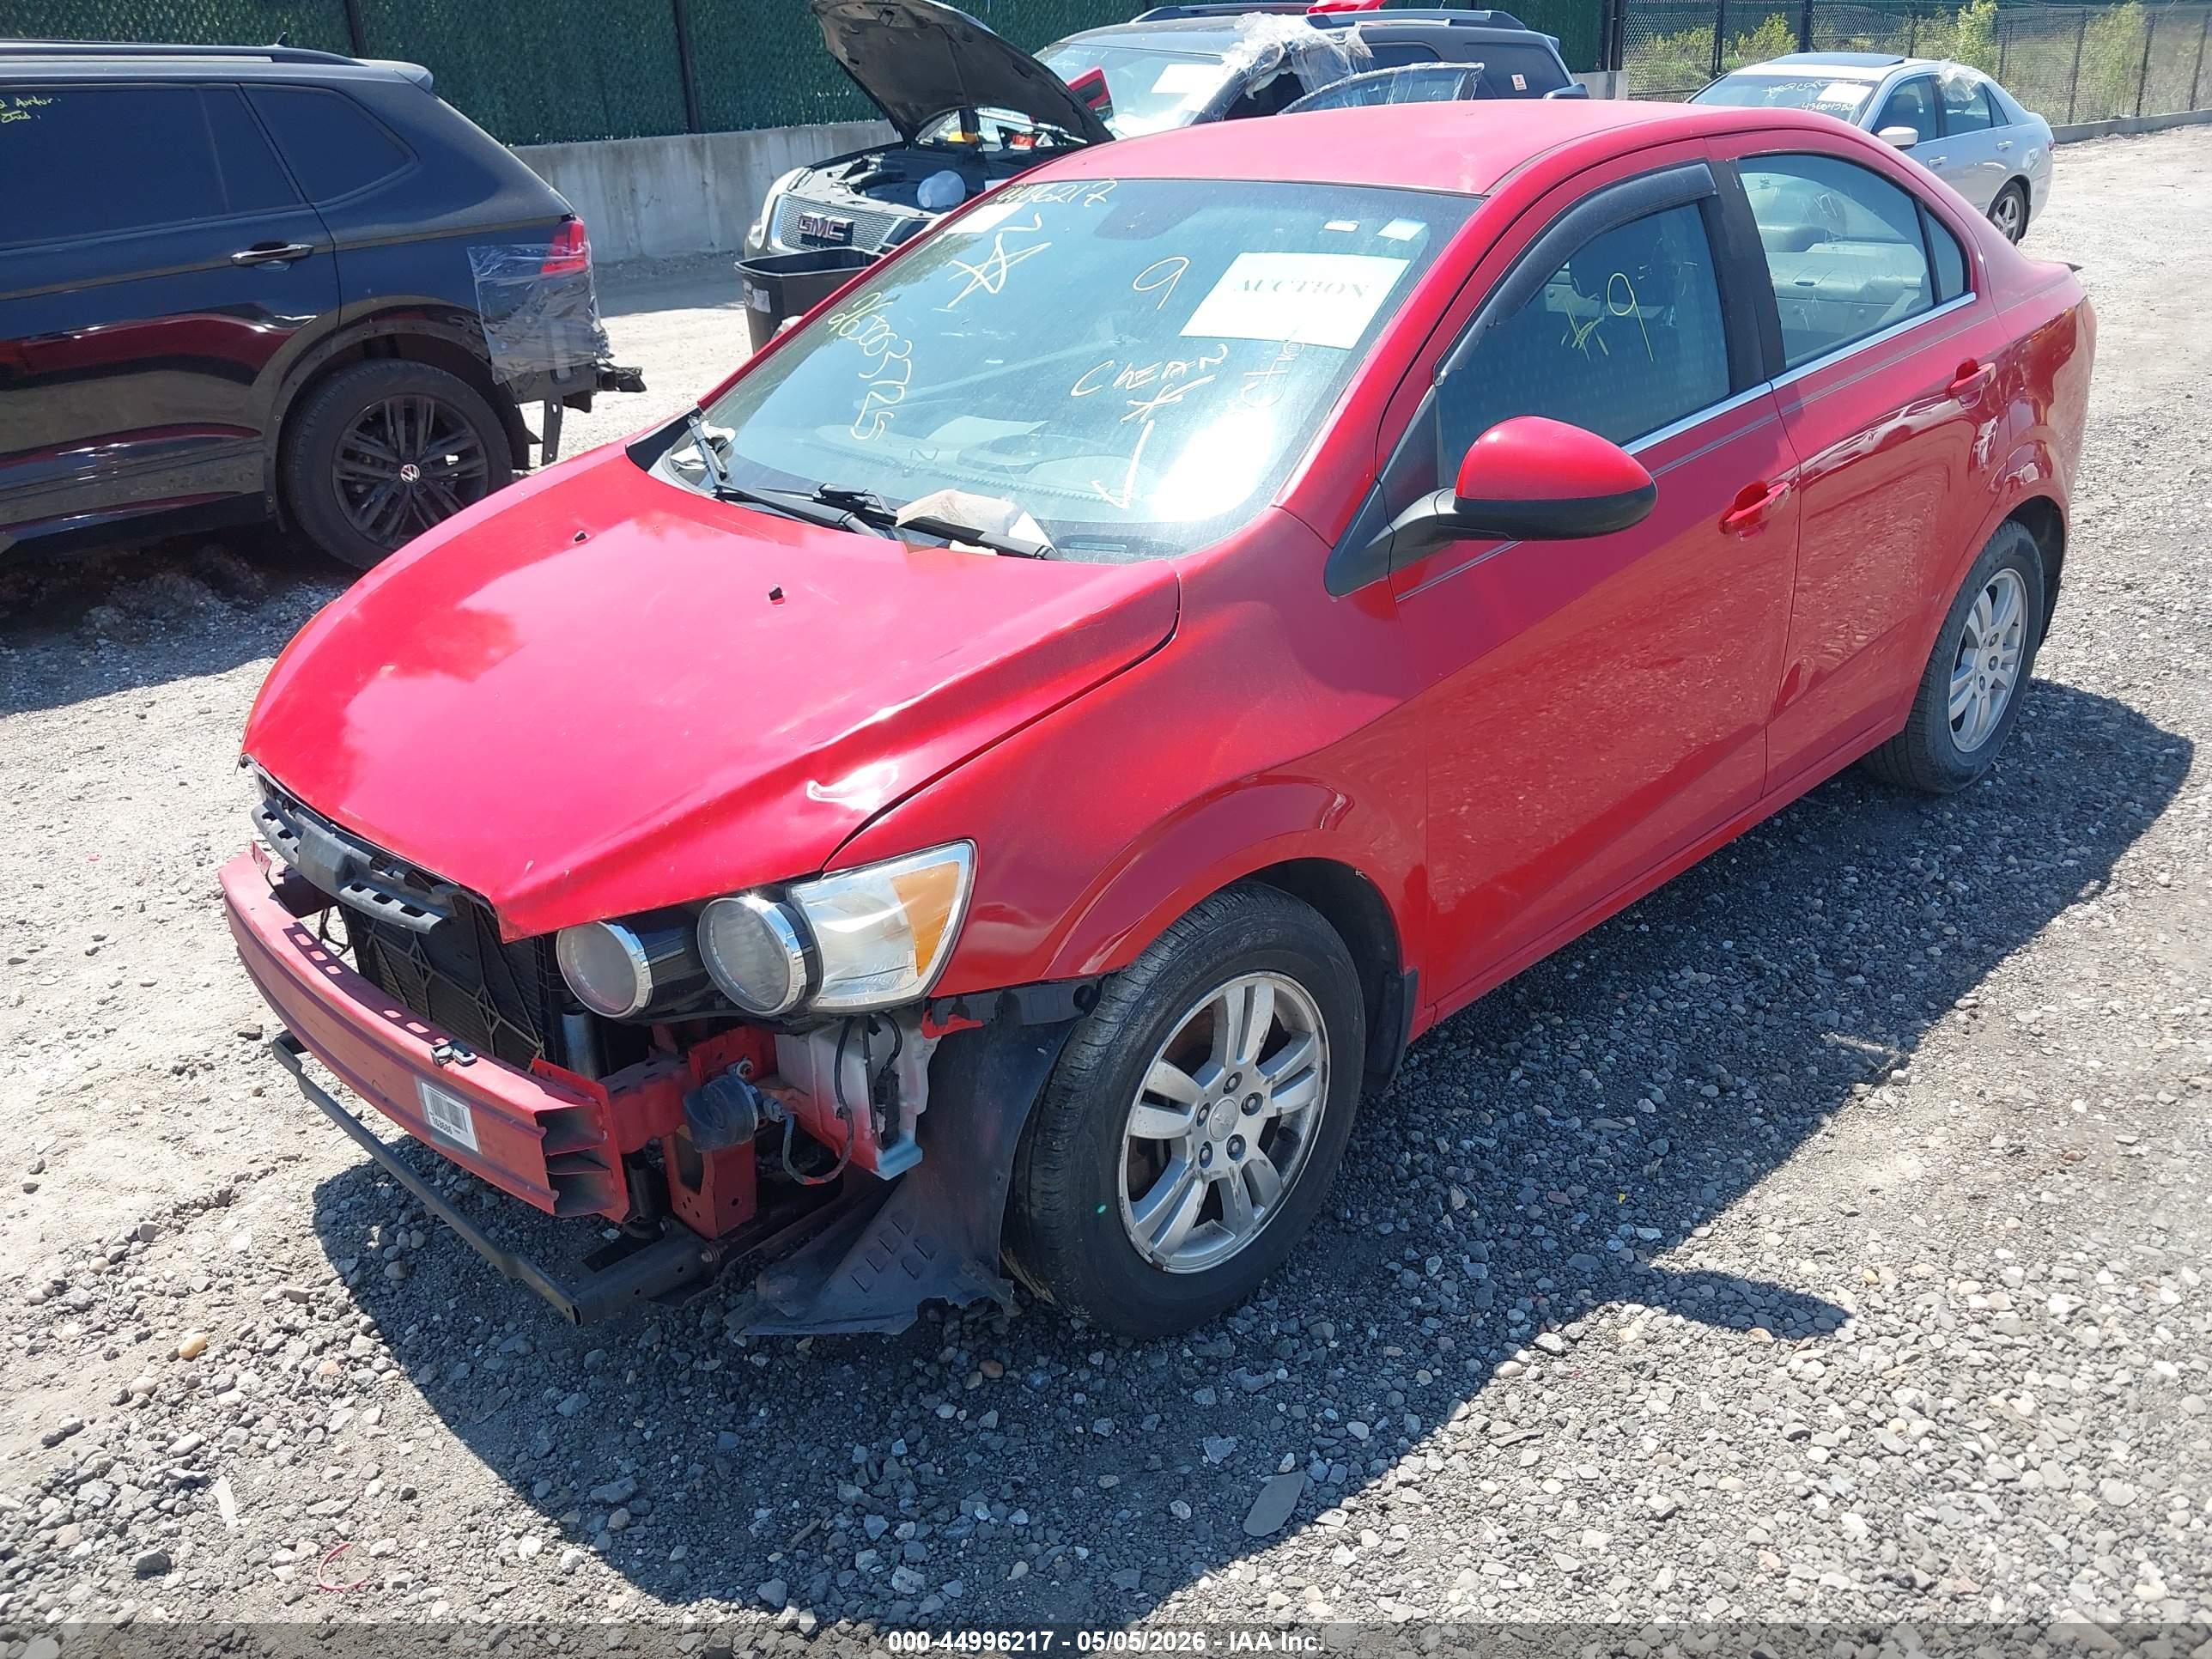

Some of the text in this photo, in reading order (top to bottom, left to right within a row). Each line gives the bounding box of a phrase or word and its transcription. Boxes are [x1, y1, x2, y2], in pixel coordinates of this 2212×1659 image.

[798, 215, 848, 242] GMC
[1133, 256, 1190, 310] 9
[1607, 272, 1654, 363] 9
